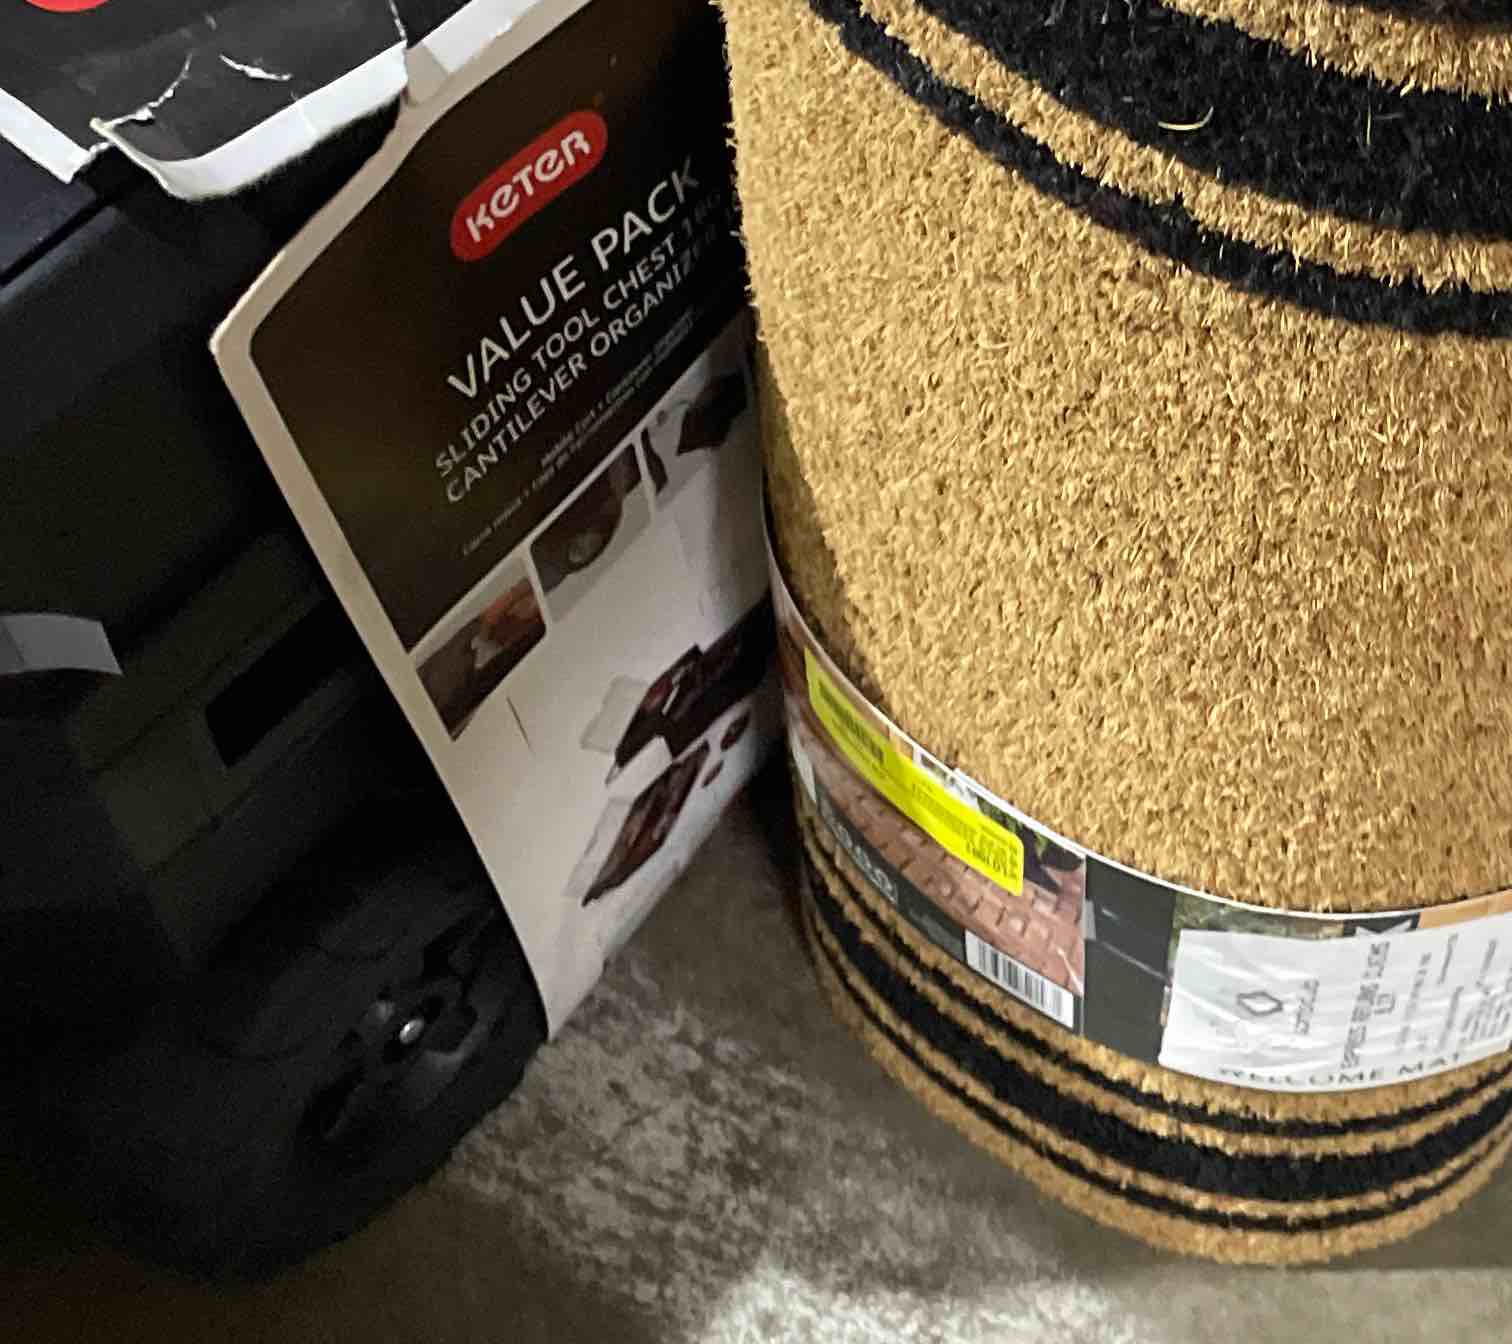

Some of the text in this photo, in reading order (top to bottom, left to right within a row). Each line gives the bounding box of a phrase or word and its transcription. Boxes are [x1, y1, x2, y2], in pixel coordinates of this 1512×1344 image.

[436, 368, 531, 479] SLIDING
[531, 308, 599, 373] TOOL
[603, 231, 676, 311] CHEST
[447, 254, 586, 400] VALUE
[591, 155, 700, 272] PACK
[446, 352, 588, 503] CANTILEVER
